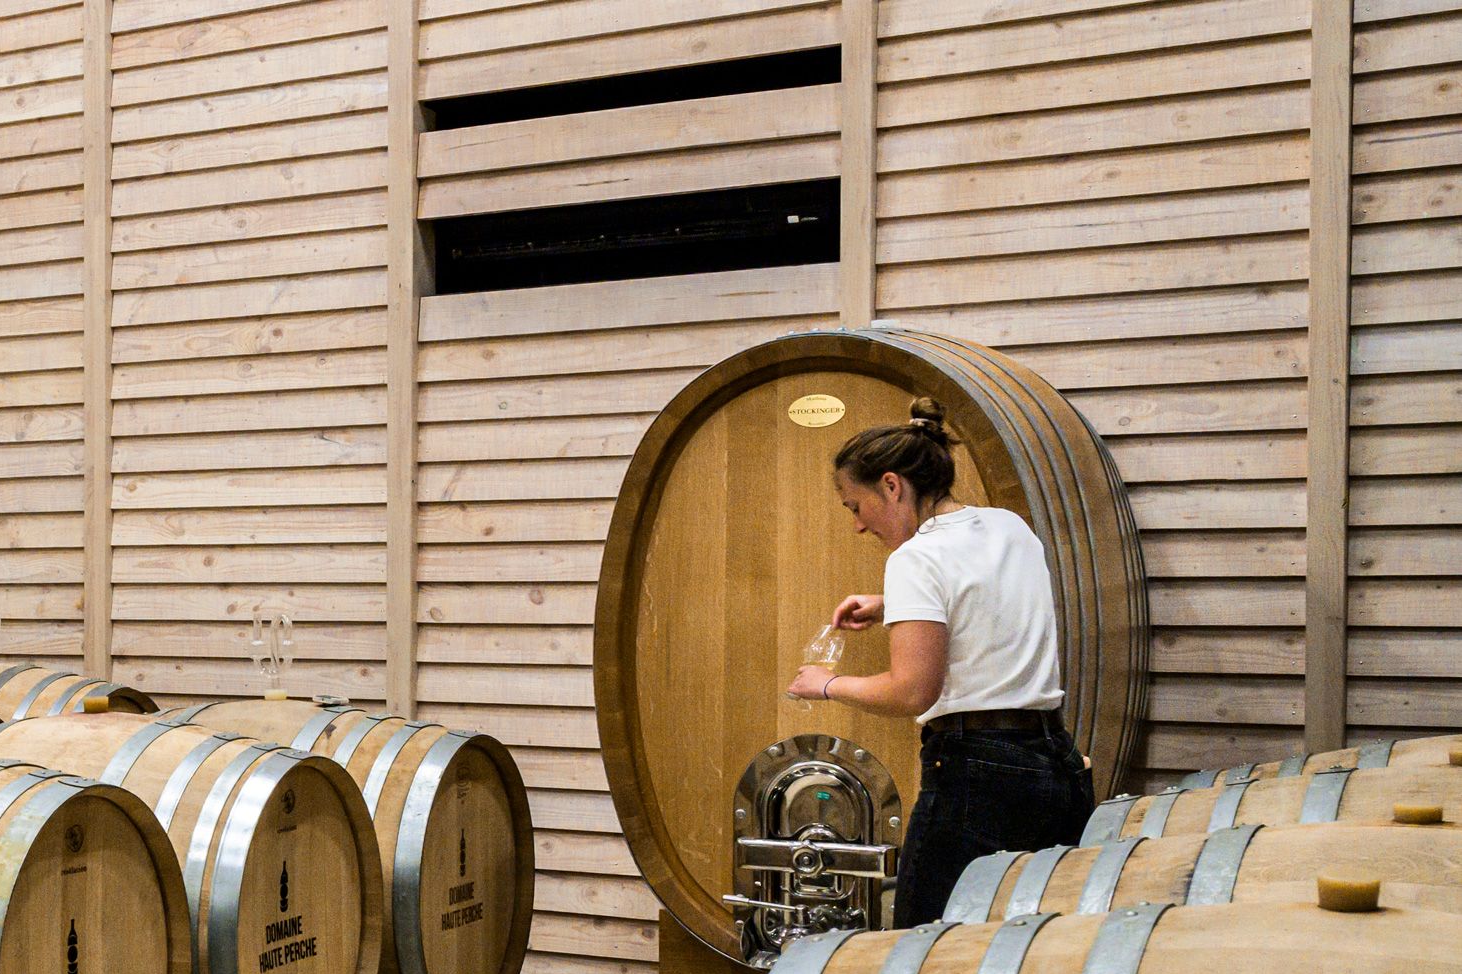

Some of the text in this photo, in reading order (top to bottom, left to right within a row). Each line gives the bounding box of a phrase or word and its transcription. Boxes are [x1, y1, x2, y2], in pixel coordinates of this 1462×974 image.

[793, 407, 840, 415] STOCKINGER
[449, 881, 474, 906] DOMAINE
[266, 915, 303, 945] DOMAINE
[441, 902, 483, 931] HAUTE PERCHE
[259, 936, 317, 974] HAUTE PERCHE
